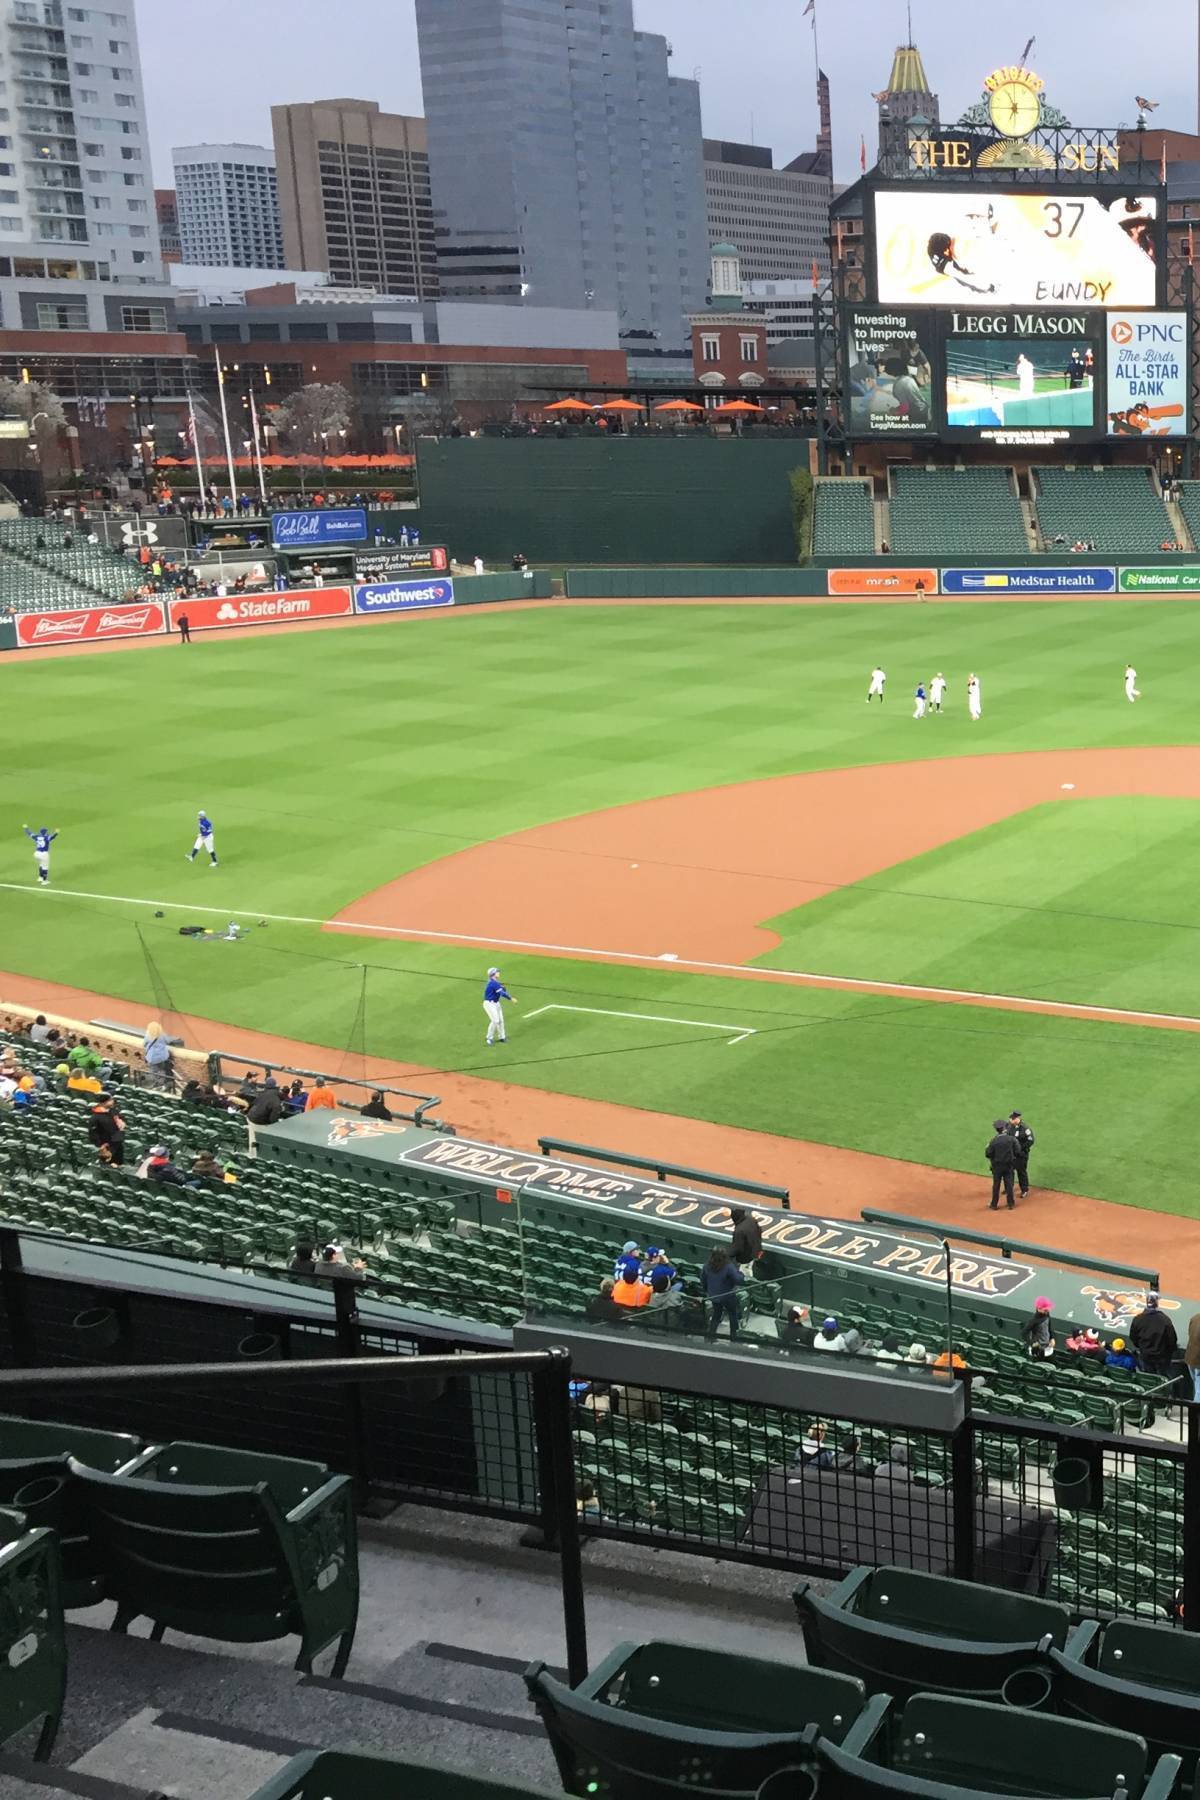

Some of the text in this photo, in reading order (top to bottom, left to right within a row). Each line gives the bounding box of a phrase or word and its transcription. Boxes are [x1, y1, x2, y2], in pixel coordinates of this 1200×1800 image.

[909, 140, 1120, 171] THE SUN
[1043, 202, 1085, 238] 37
[854, 313, 907, 327] Investing
[952, 313, 1087, 335] LEGG MASON
[854, 328, 917, 341] to Improve
[1136, 324, 1184, 343] PNC
[1118, 349, 1175, 363] The Birds
[1115, 363, 1179, 380] ALL-STAR
[1129, 381, 1164, 396] BANK
[276, 516, 297, 536] Bob
[356, 552, 431, 565] University of Maryland
[385, 562, 409, 571] System
[1010, 575, 1095, 586] MedStar Health
[1138, 575, 1179, 584] National
[1182, 576, 1198, 584] Car
[365, 587, 436, 605] Southwest
[37, 621, 83, 633] Budweiser
[100, 614, 145, 627] Budweiser
[420, 1141, 634, 1202] WELCOME
[628, 1189, 699, 1218] TO
[879, 1244, 1022, 1294] PARK
